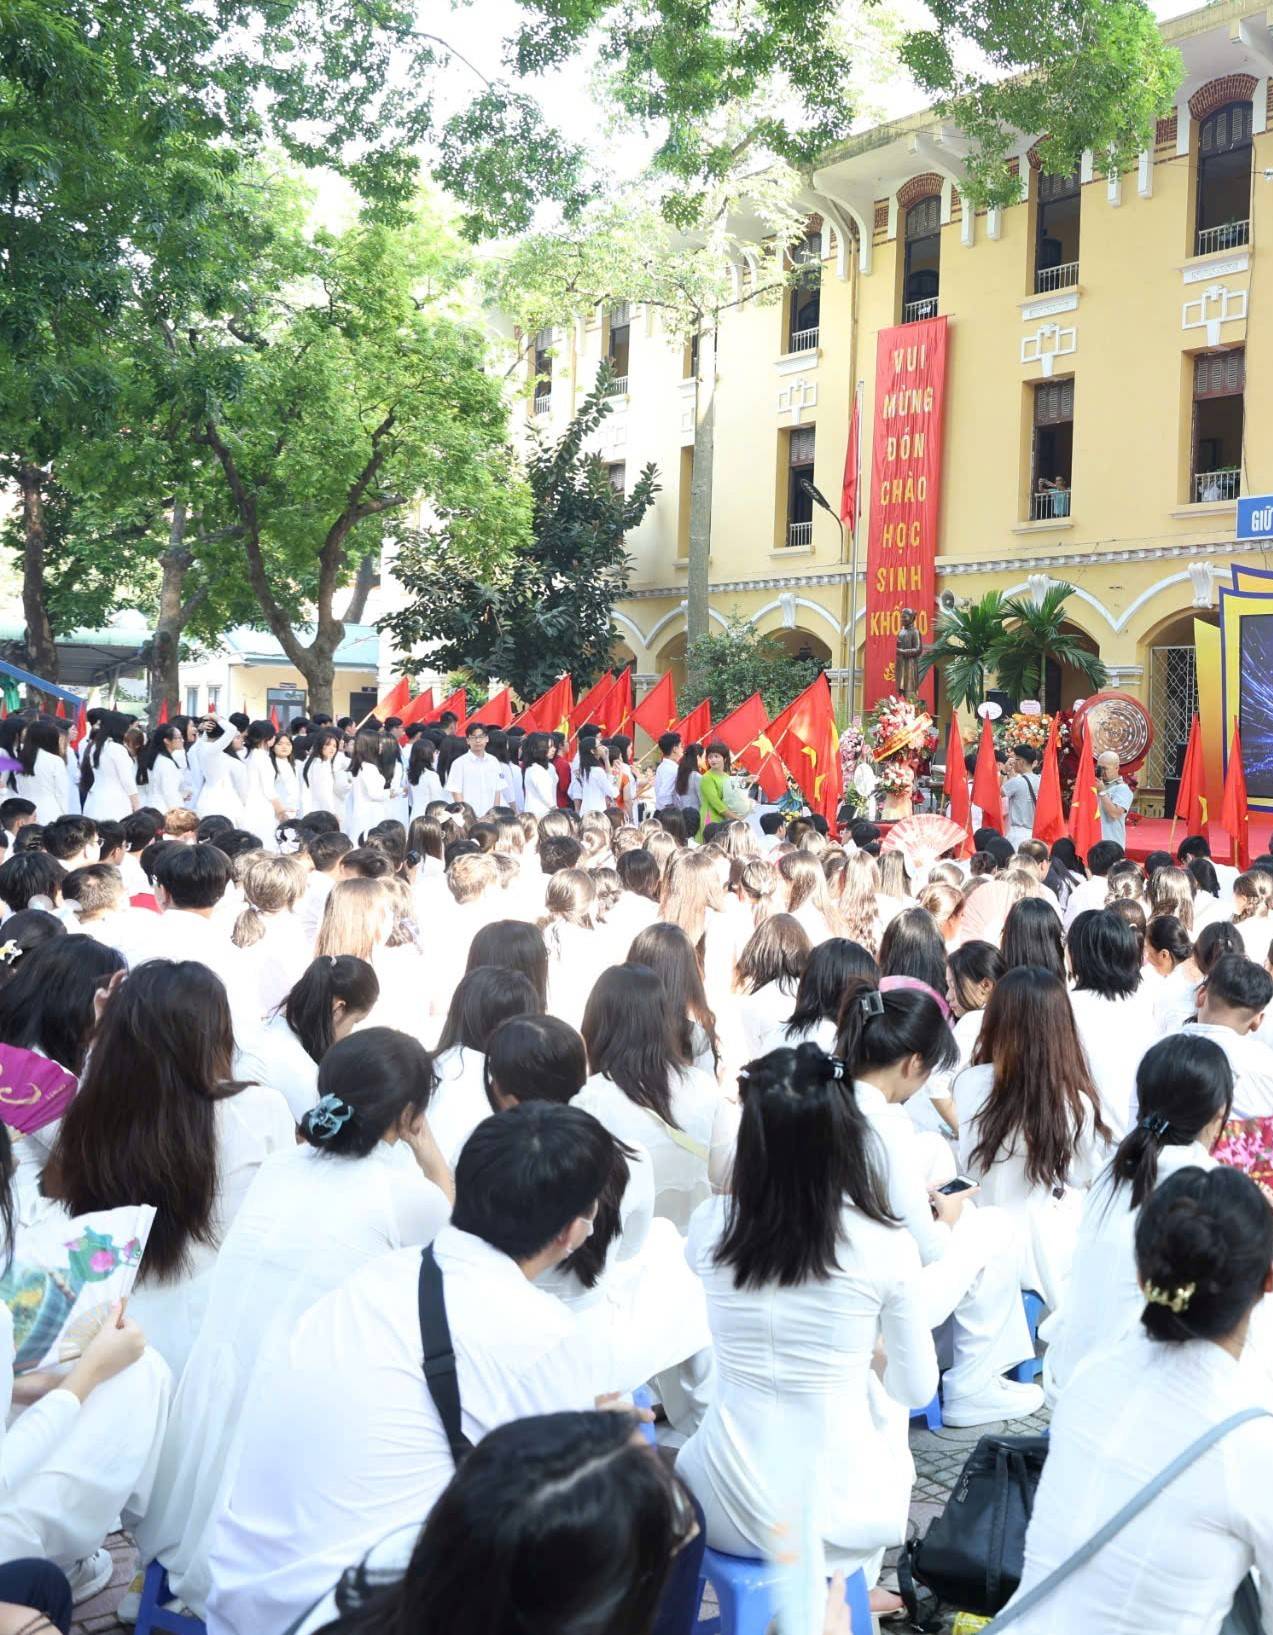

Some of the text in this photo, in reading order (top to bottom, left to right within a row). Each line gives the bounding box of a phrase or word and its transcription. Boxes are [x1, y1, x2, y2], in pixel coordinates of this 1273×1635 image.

[893, 344, 926, 374] VUI
[882, 384, 933, 419] MỪNG
[886, 426, 925, 461] ĐÓN
[881, 471, 927, 506] CHÀO
[1251, 504, 1273, 532] GIỮ
[882, 521, 921, 554] HỌC
[876, 564, 922, 593] SINH
[871, 600, 901, 636] KHỐ
